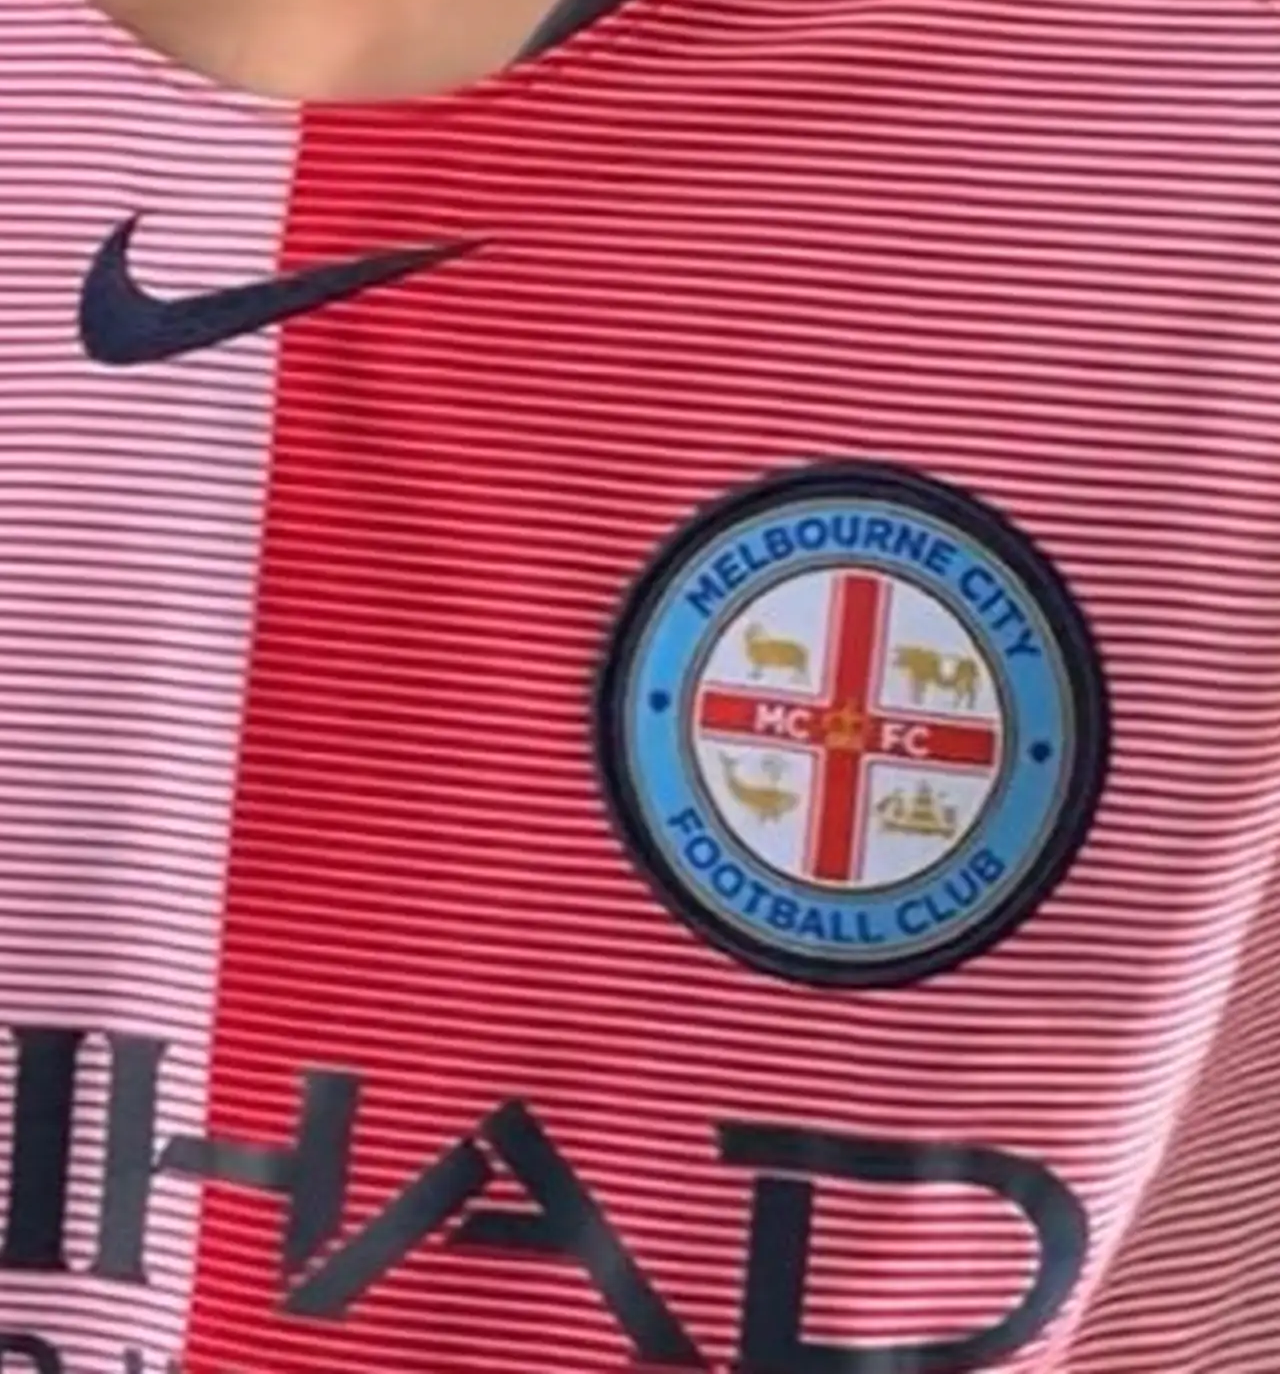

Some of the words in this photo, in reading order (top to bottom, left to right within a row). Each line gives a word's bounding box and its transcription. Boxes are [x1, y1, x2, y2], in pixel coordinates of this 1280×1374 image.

[685, 515, 958, 619] MELBOURNE
[957, 564, 1041, 659] CITY
[754, 705, 812, 739] MC
[882, 726, 930, 757] FC
[666, 807, 885, 943] FOOTBALL
[896, 849, 1005, 935] CLUB
